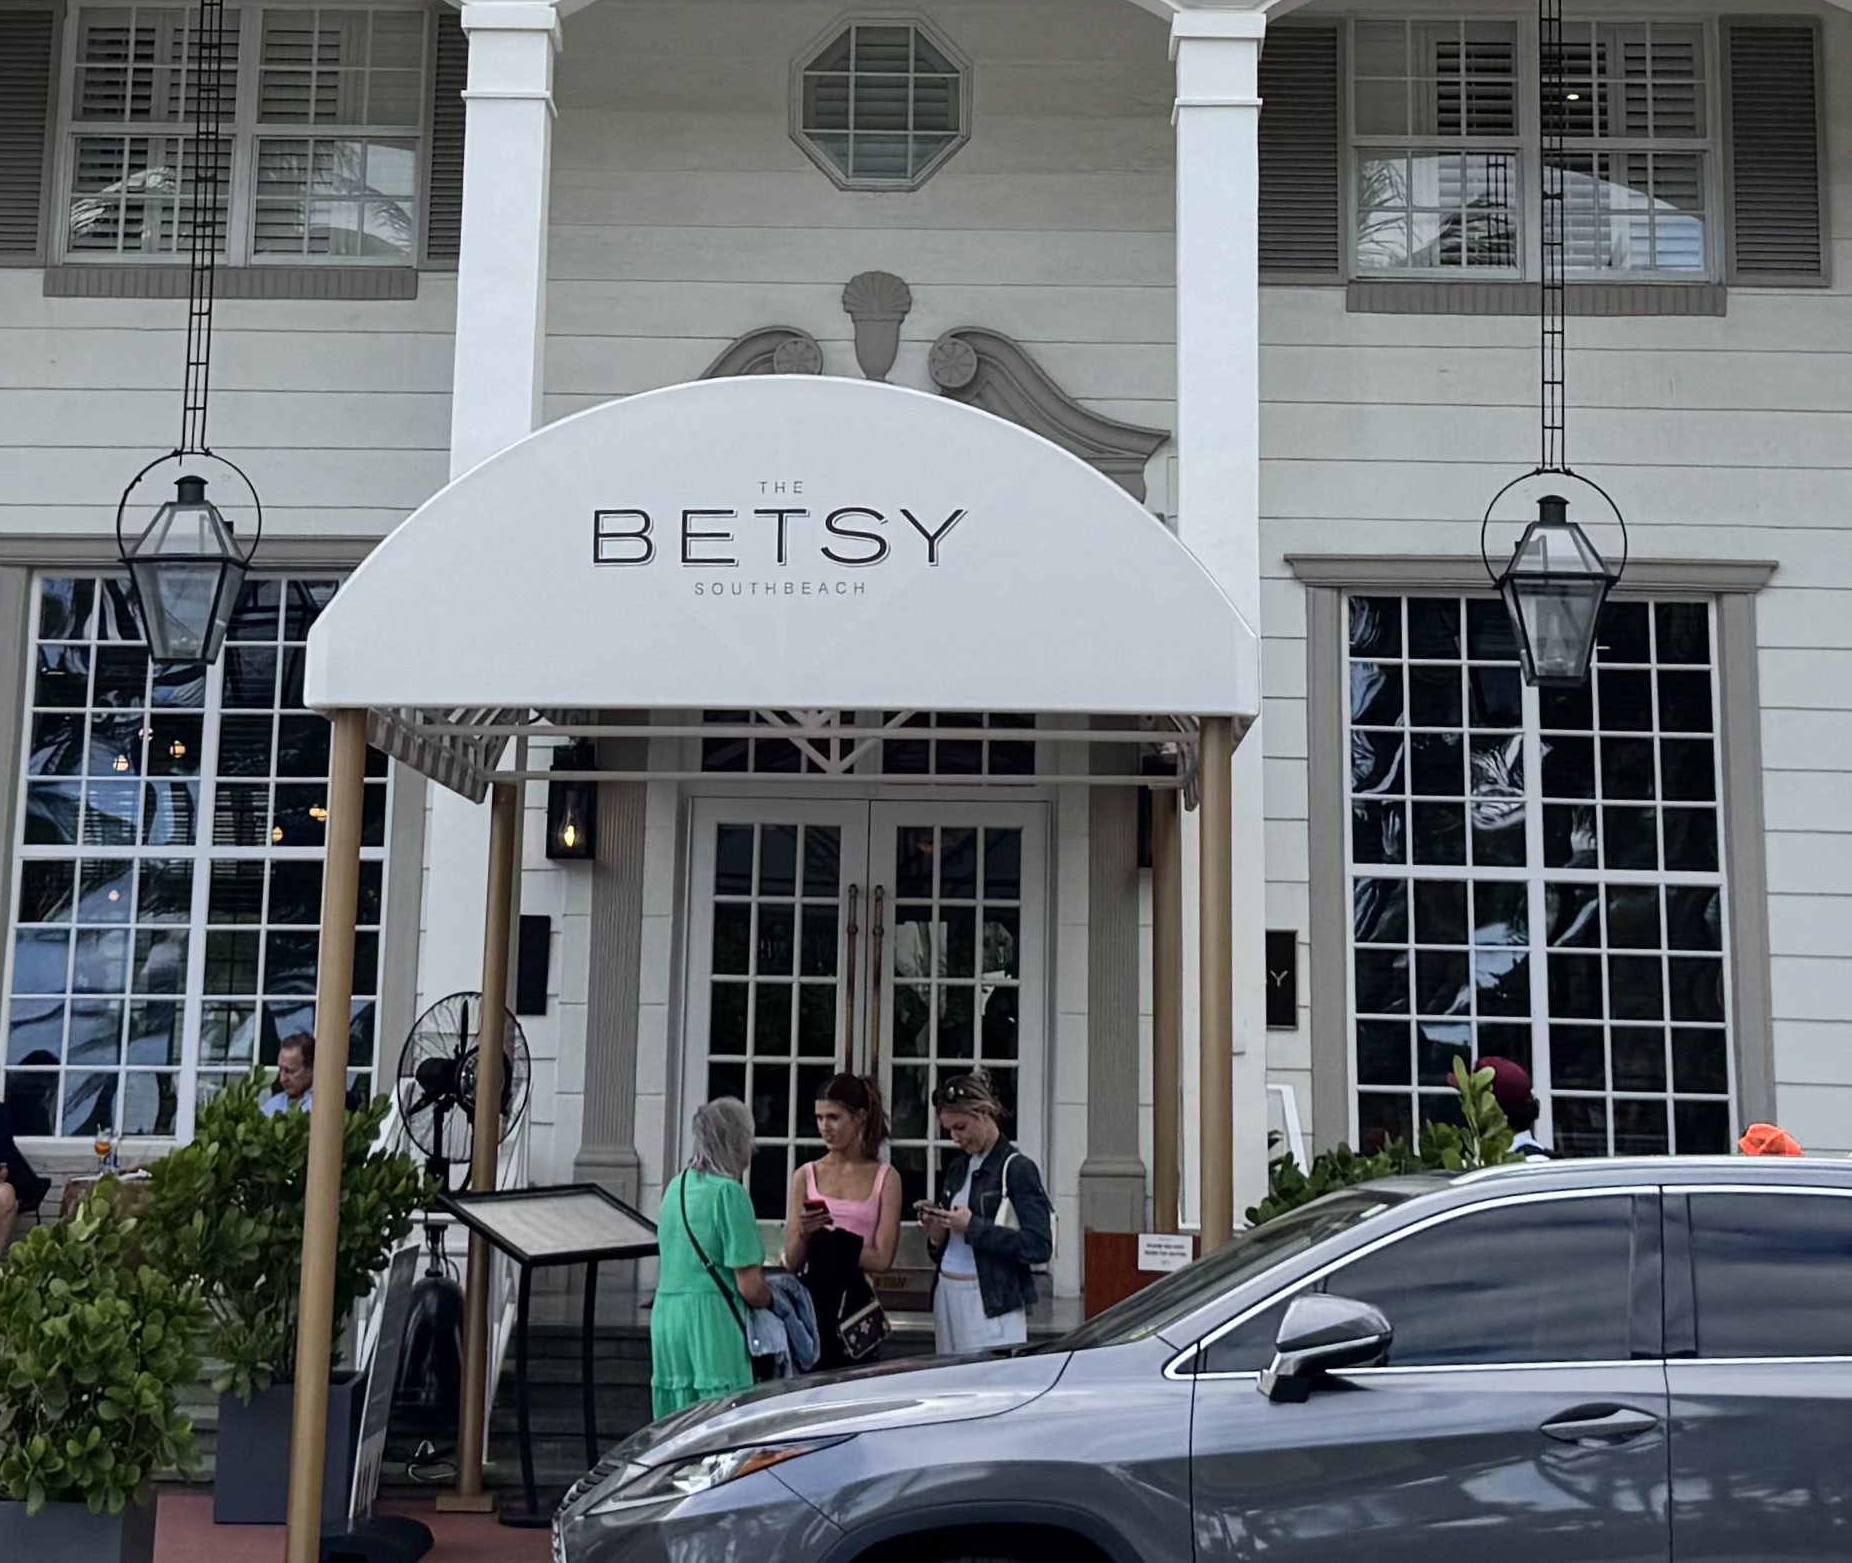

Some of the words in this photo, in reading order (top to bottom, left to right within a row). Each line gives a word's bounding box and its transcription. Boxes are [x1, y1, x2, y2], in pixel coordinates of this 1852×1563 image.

[759, 480, 805, 495] THE
[593, 507, 967, 566] BETSY
[694, 581, 866, 596] SOUTHBEACH
